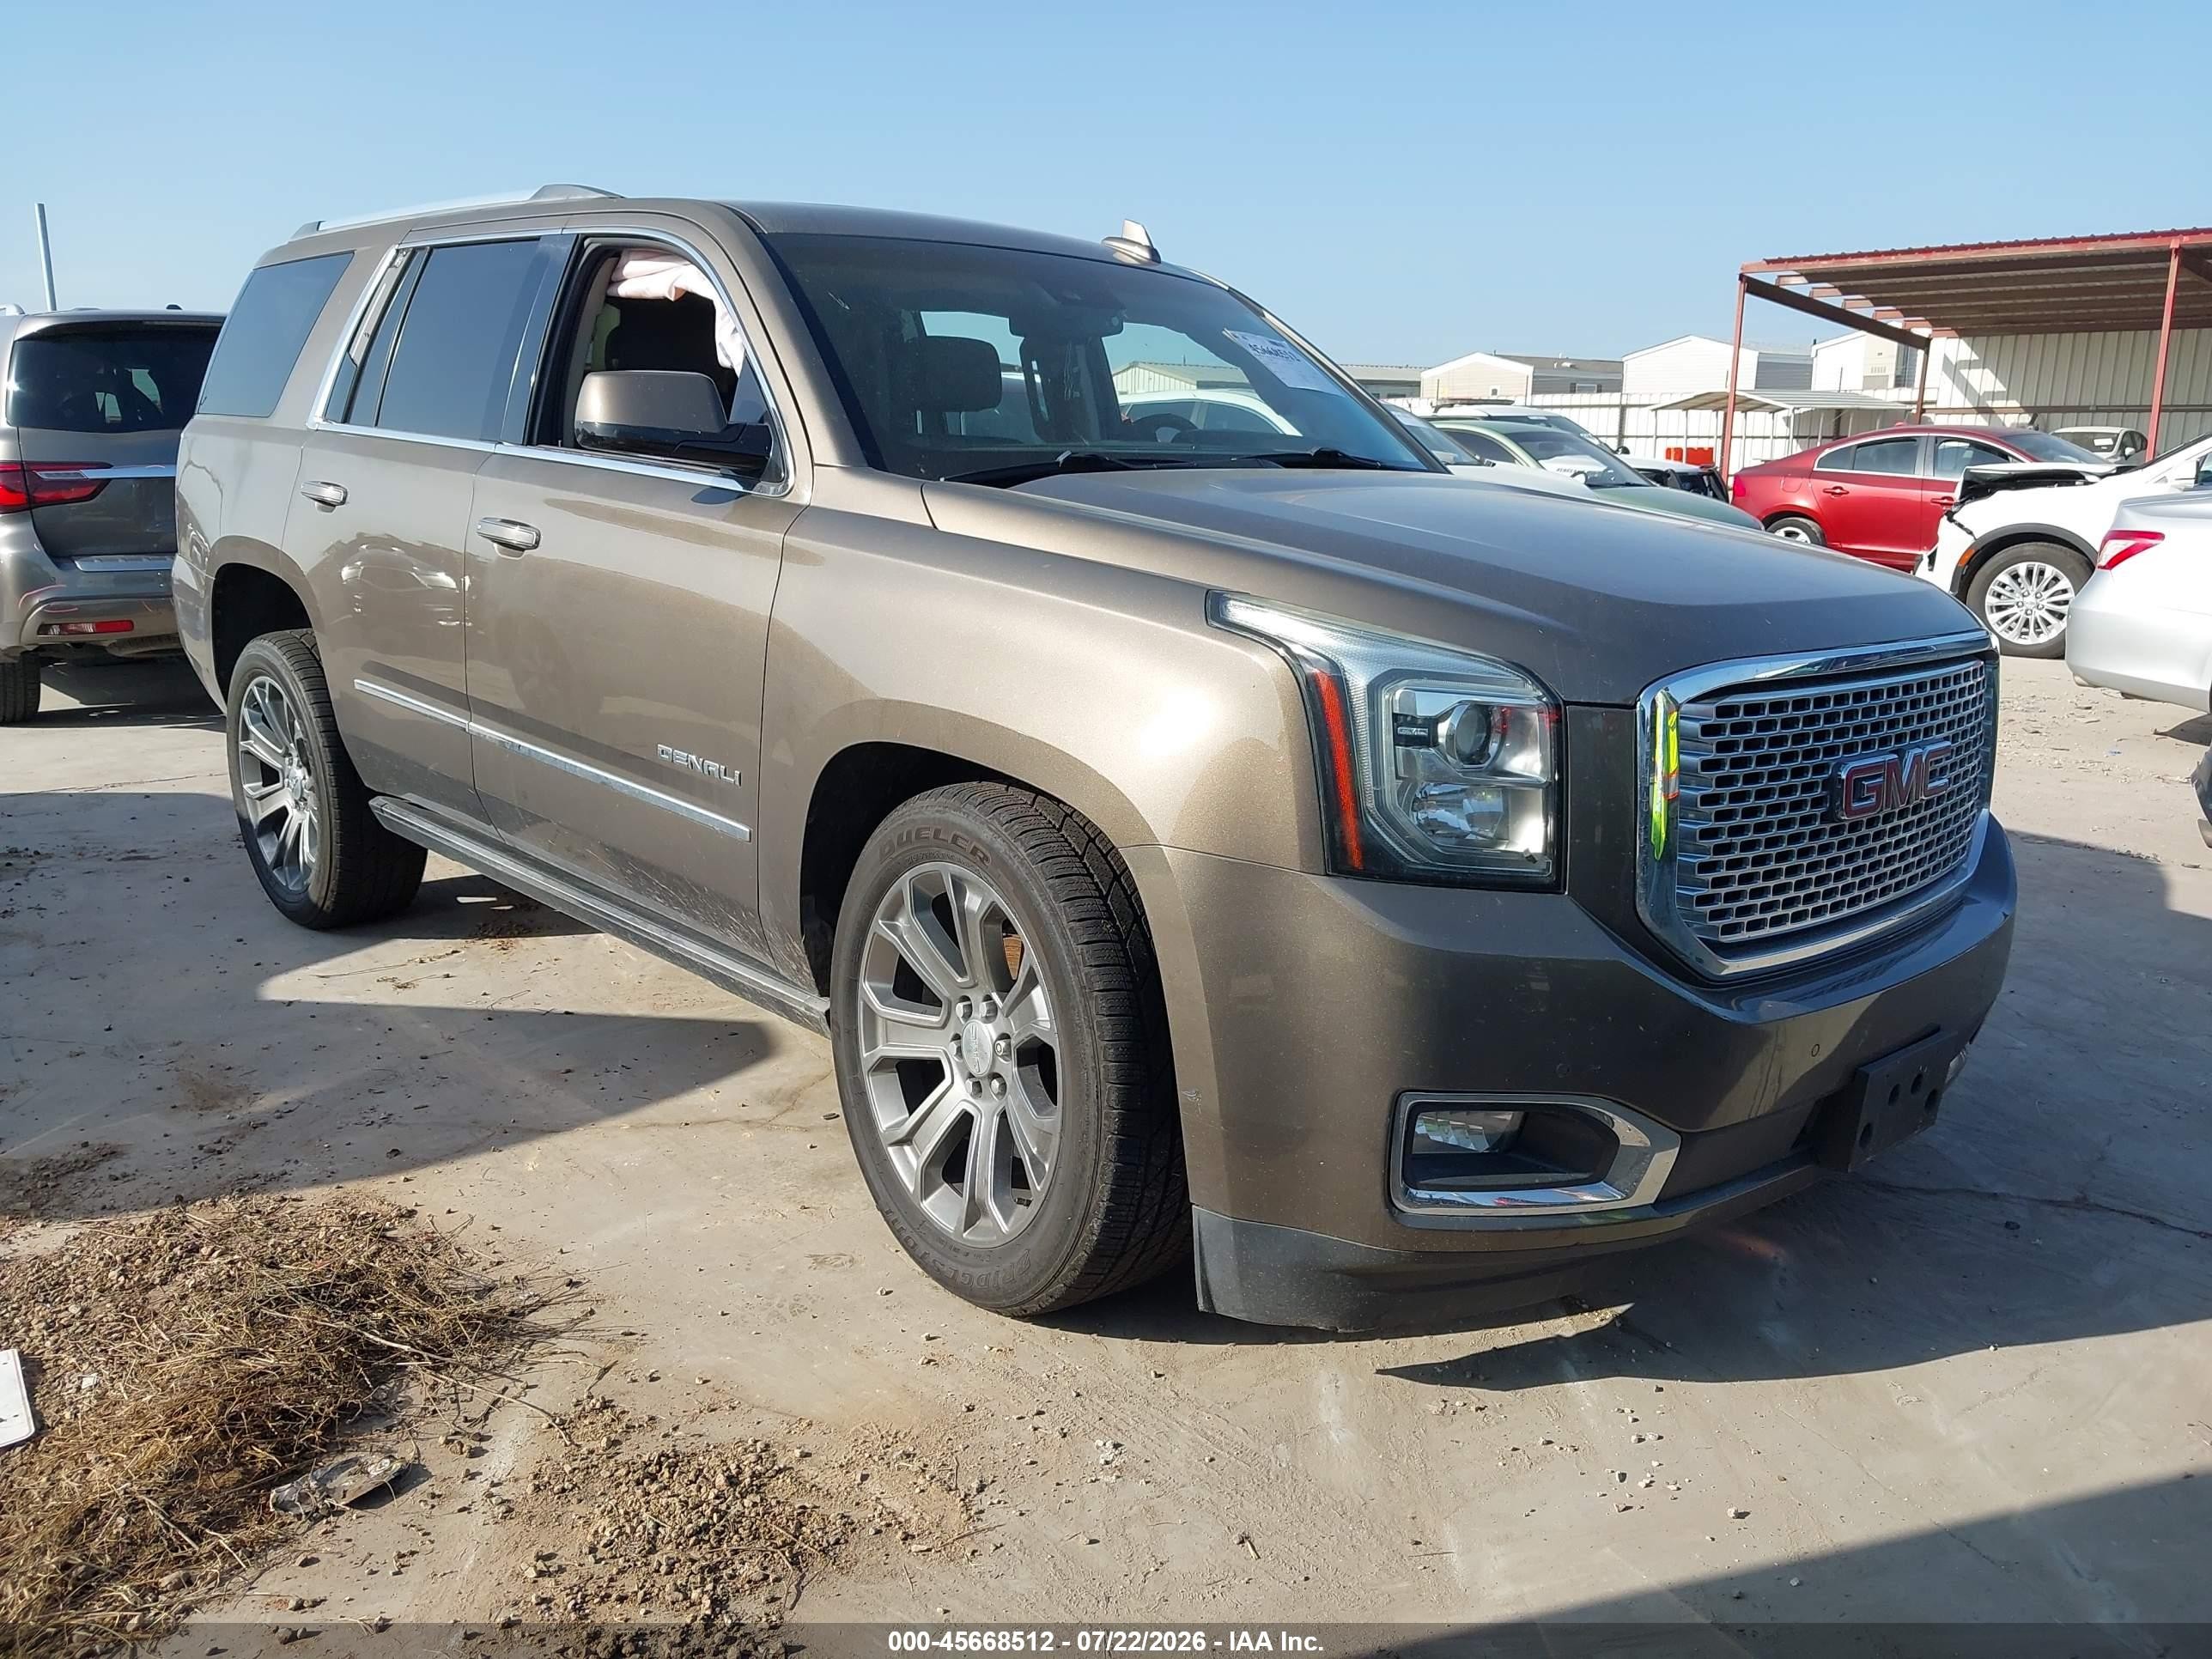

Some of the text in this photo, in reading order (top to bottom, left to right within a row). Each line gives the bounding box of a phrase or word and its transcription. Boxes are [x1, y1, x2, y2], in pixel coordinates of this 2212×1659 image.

[657, 744, 742, 787] DENALI
[1840, 740, 1952, 820] GMC
[878, 825, 992, 869] DUELER
